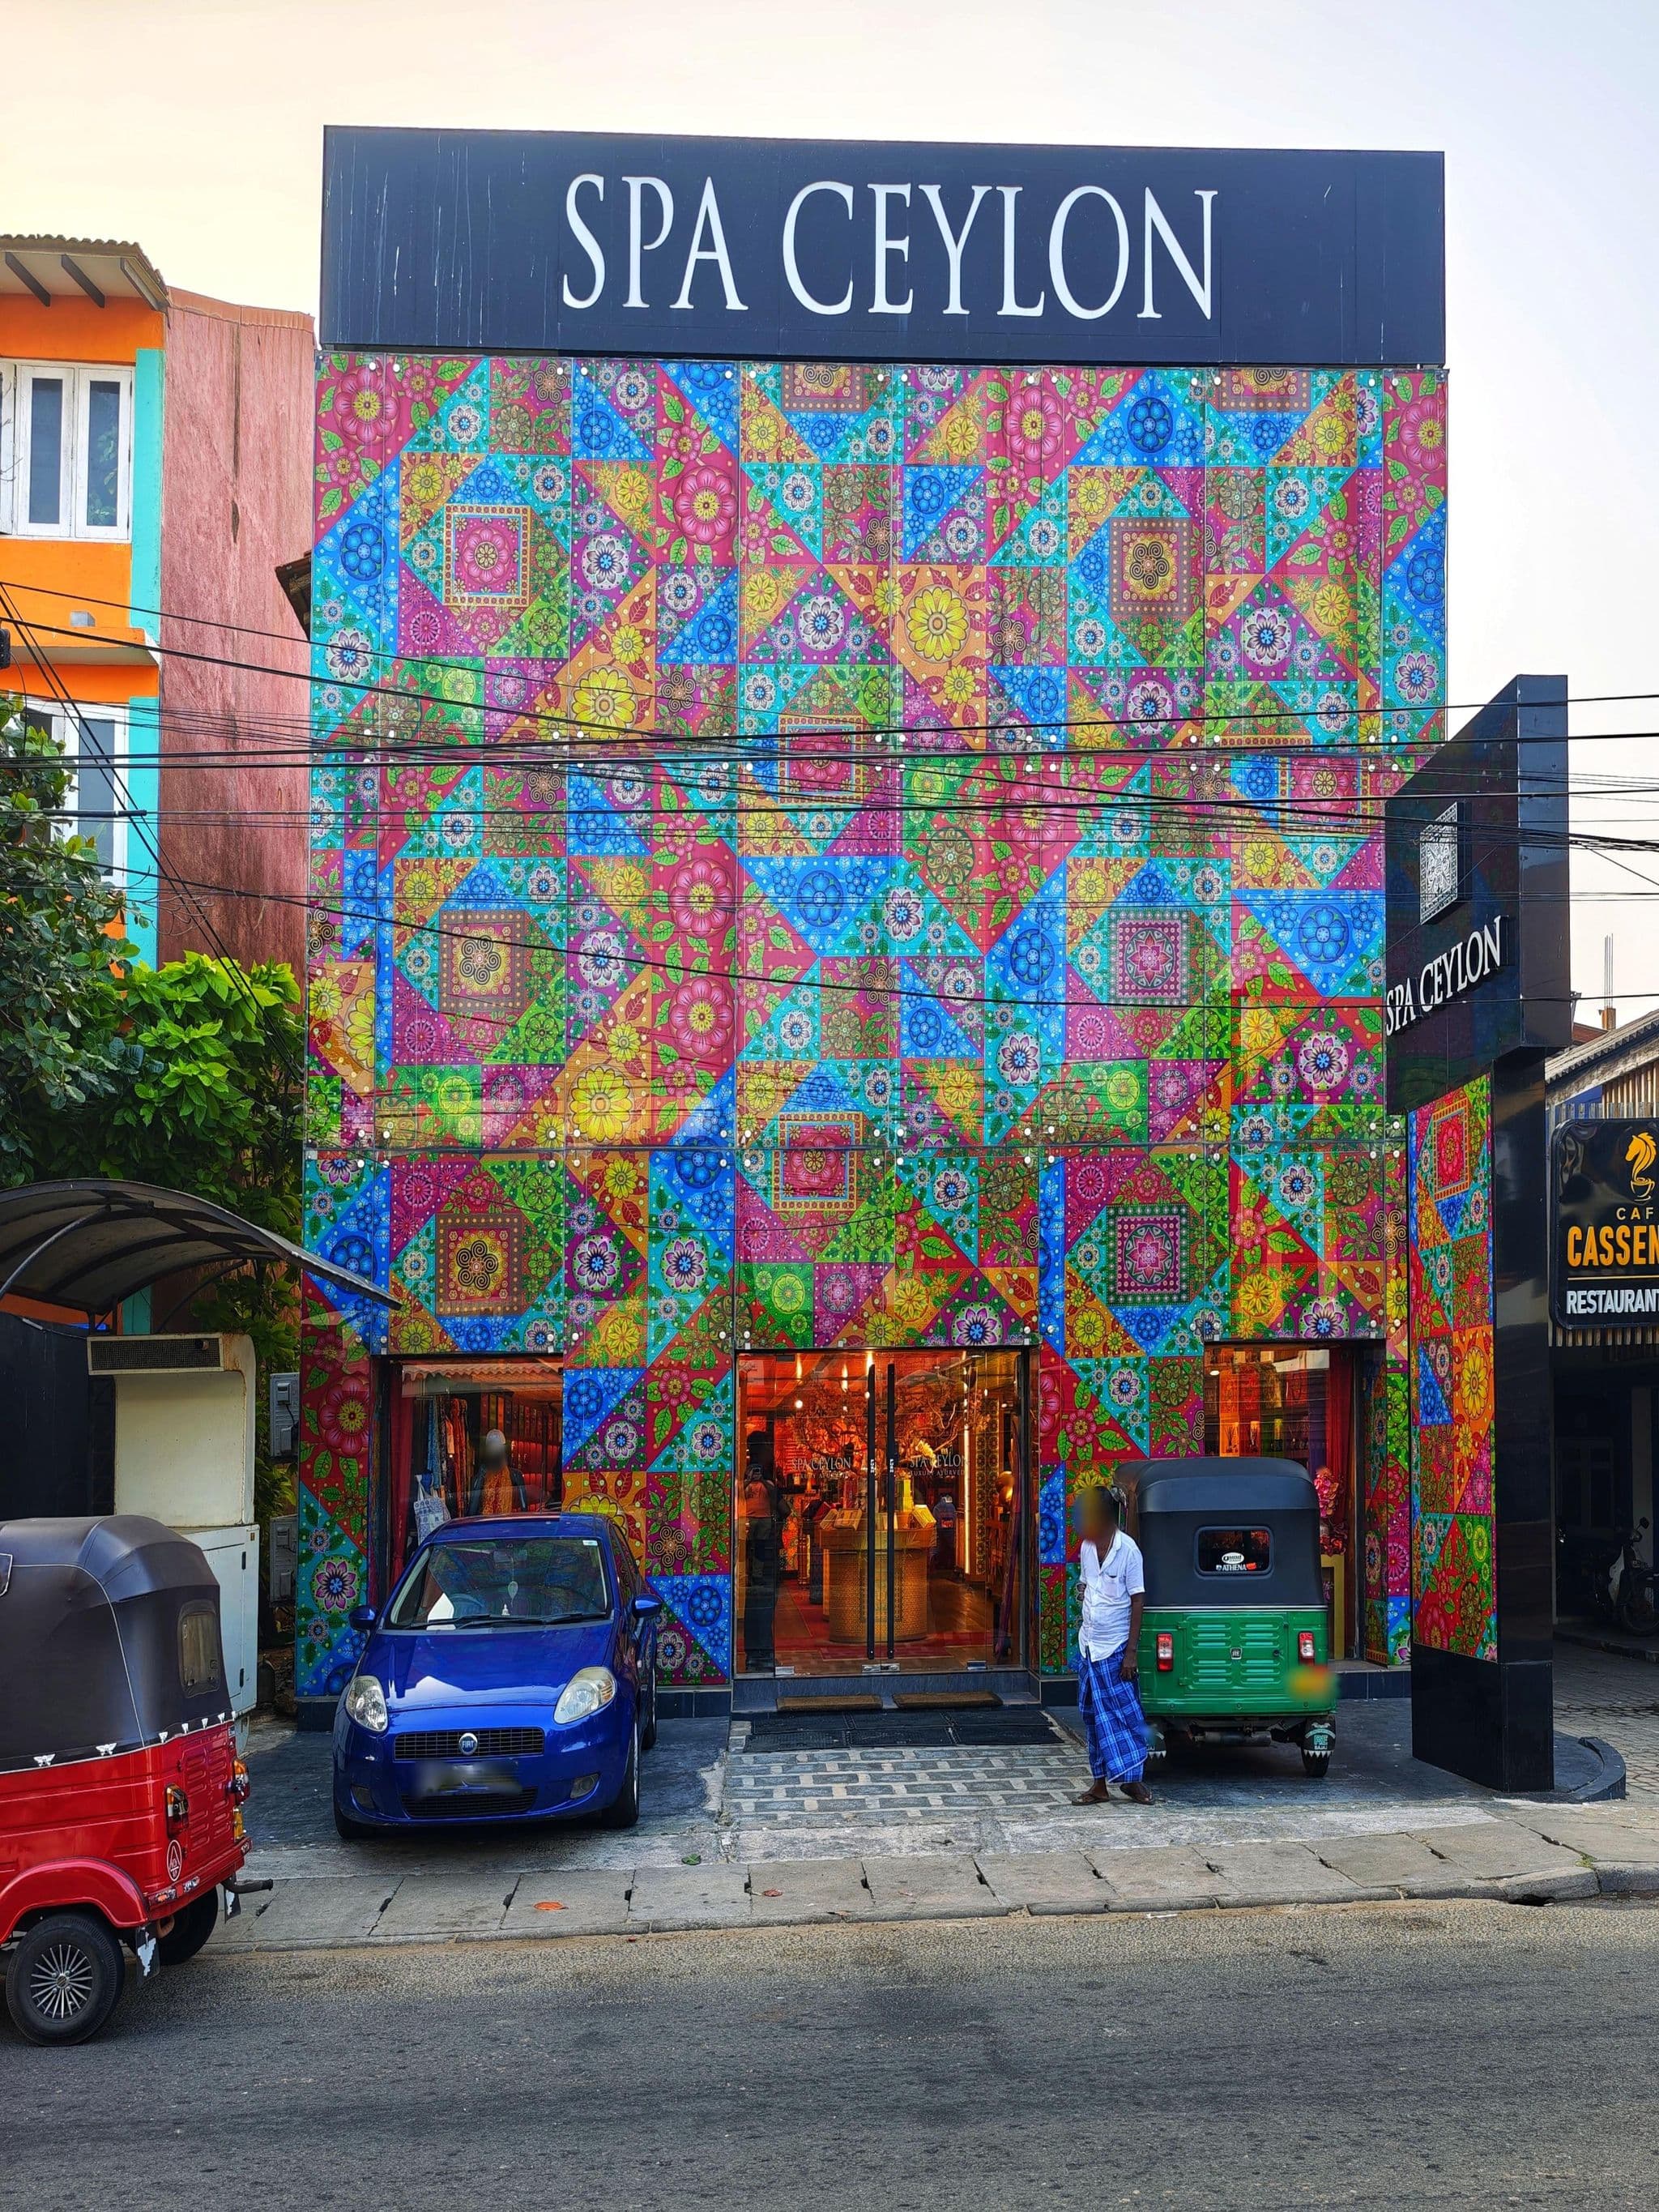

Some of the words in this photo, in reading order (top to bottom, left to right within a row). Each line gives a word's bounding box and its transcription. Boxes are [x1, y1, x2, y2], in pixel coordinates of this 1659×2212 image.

[562, 173, 748, 310] SPA
[782, 181, 1218, 320] CEYLON
[1386, 977, 1416, 1036] SPA
[1419, 915, 1501, 1012] CEYLON
[811, 1457, 851, 1471] CEYLON
[931, 1454, 965, 1467] EYLO
[462, 1740, 474, 1749] FIAT
